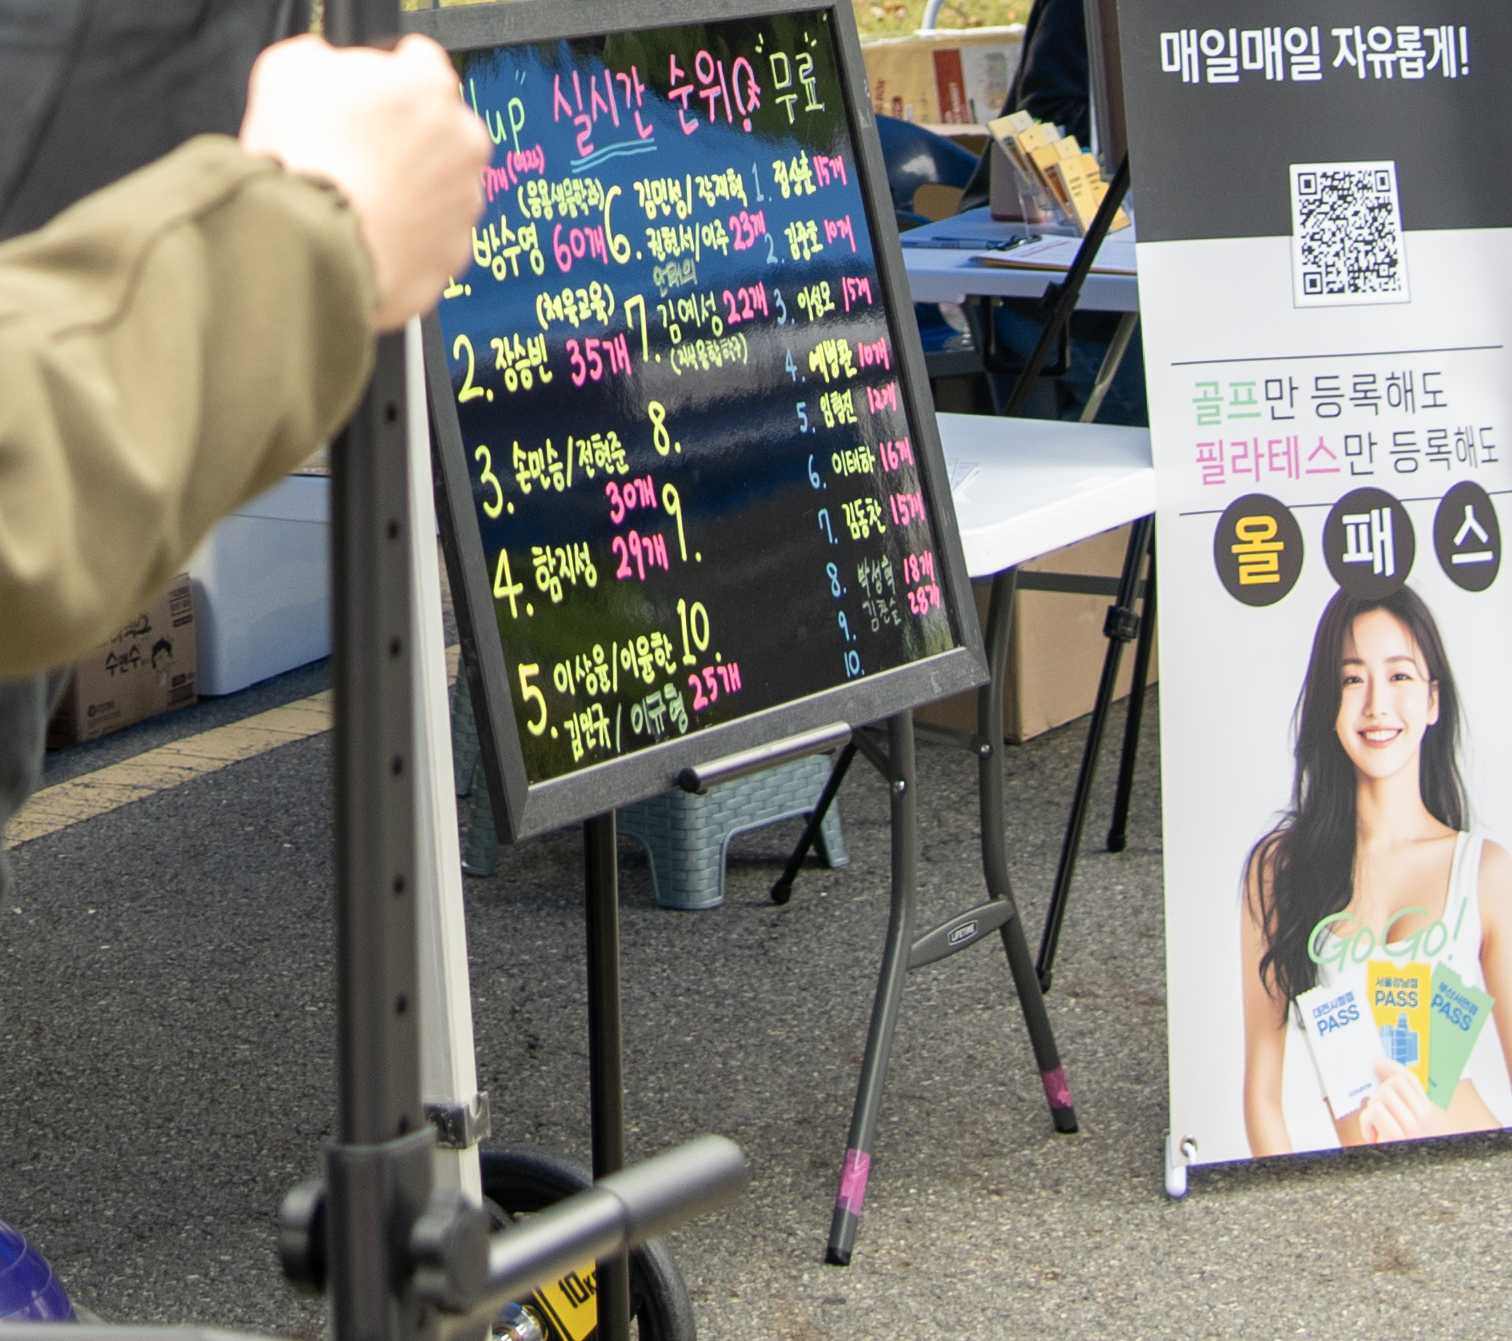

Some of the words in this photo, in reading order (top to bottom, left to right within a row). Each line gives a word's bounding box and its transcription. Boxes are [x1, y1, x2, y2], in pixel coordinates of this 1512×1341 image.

[1160, 26, 1323, 84] 매일매일
[1331, 25, 1469, 80] 자유롭게!
[486, 97, 526, 155] up
[553, 65, 654, 157] 실시간
[770, 51, 824, 125] 무료
[751, 161, 773, 203] 1.
[553, 223, 609, 273] 60개
[604, 185, 643, 265] 6.
[729, 210, 766, 252] 23개
[764, 232, 786, 265] 2.
[624, 293, 661, 363] 7.
[657, 290, 724, 345] 김예성
[723, 281, 769, 325] 22개
[773, 288, 796, 325] 3.
[453, 333, 494, 403] 2.
[566, 332, 632, 387] 35개
[785, 348, 807, 383] 4.
[796, 402, 816, 434] 5.
[1192, 374, 1299, 427] 골프만
[1310, 369, 1448, 419] 등록해도
[648, 400, 682, 457] 8.
[474, 445, 515, 519] 3.
[807, 454, 827, 489] 6.
[879, 436, 914, 472] 16개
[1195, 431, 1377, 487] 필라테스만
[1389, 425, 1499, 475] 등록해도
[606, 474, 658, 524] 30개
[662, 482, 702, 563] 9.
[817, 508, 838, 545] 7.
[889, 491, 925, 525] 15개
[493, 548, 534, 619] 4.
[612, 529, 669, 581] 29개
[826, 561, 847, 598] 8.
[676, 598, 722, 666] 10.
[838, 611, 857, 642] 9.
[688, 662, 742, 712] 25개
[843, 649, 865, 679] 10.
[518, 662, 558, 740] 5.
[1317, 1003, 1361, 1037] PASS
[1375, 990, 1419, 1008] PASS
[1431, 994, 1474, 1032] PASS
